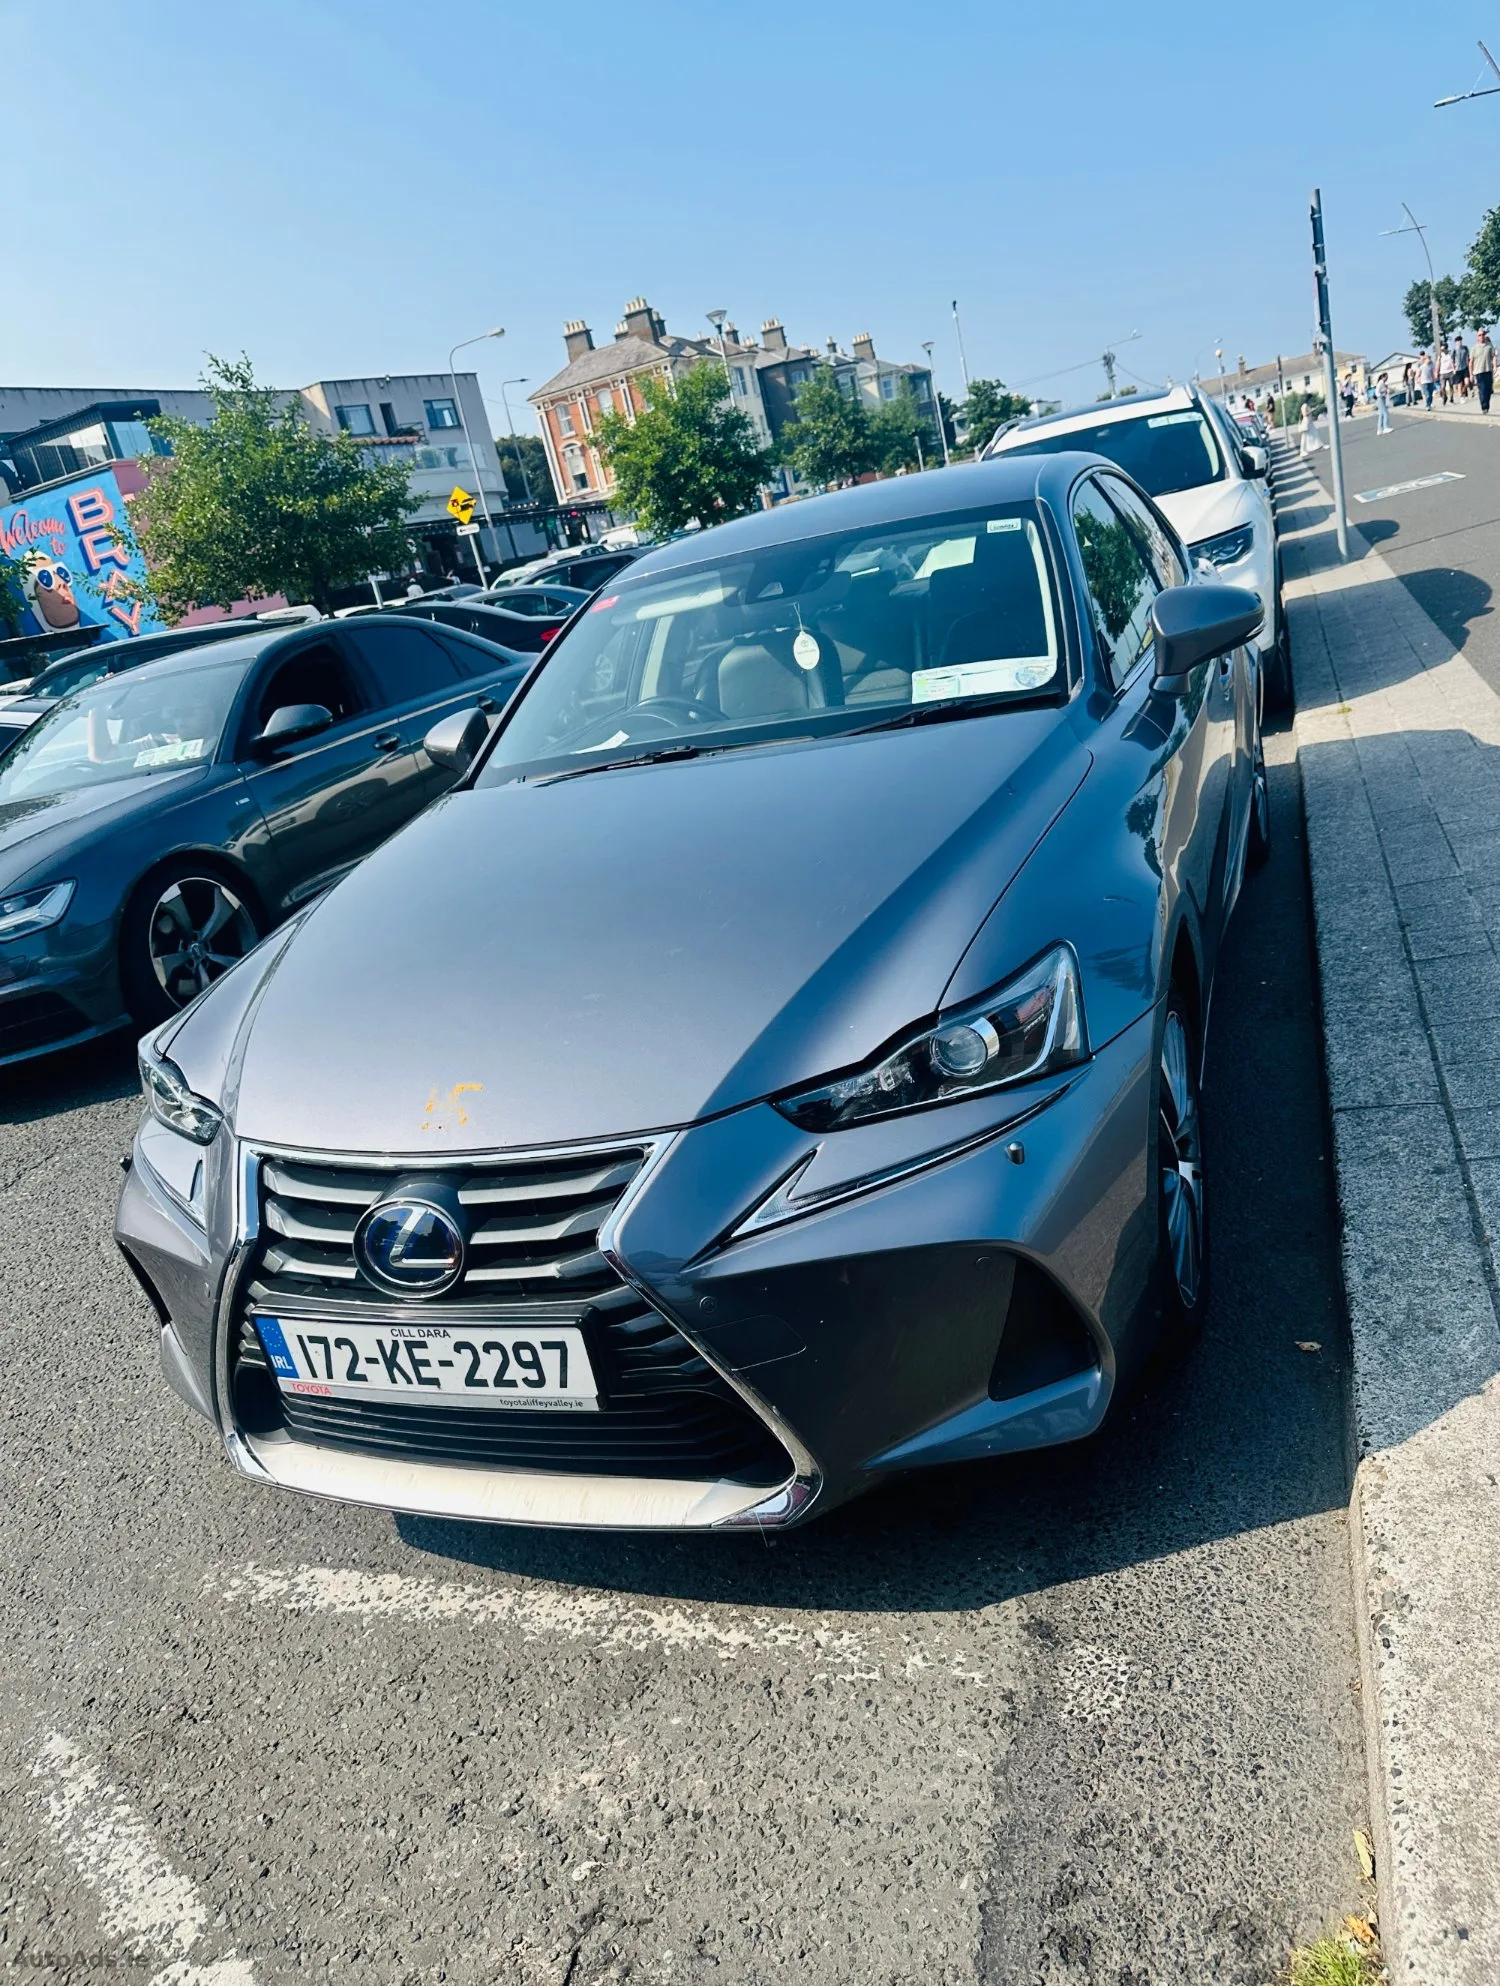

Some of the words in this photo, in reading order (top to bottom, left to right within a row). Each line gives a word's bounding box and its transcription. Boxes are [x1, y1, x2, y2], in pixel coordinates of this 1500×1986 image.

[51, 536, 66, 556] to
[67, 487, 143, 636] BRAY
[390, 1328, 416, 1338] CILL
[417, 1328, 451, 1339] DARA
[270, 1354, 293, 1370] IRL
[297, 1334, 569, 1390] 172-KE-2297
[291, 1383, 332, 1395] TOYOTA
[499, 1398, 584, 1409] toyotaliffeyvalley.ie
